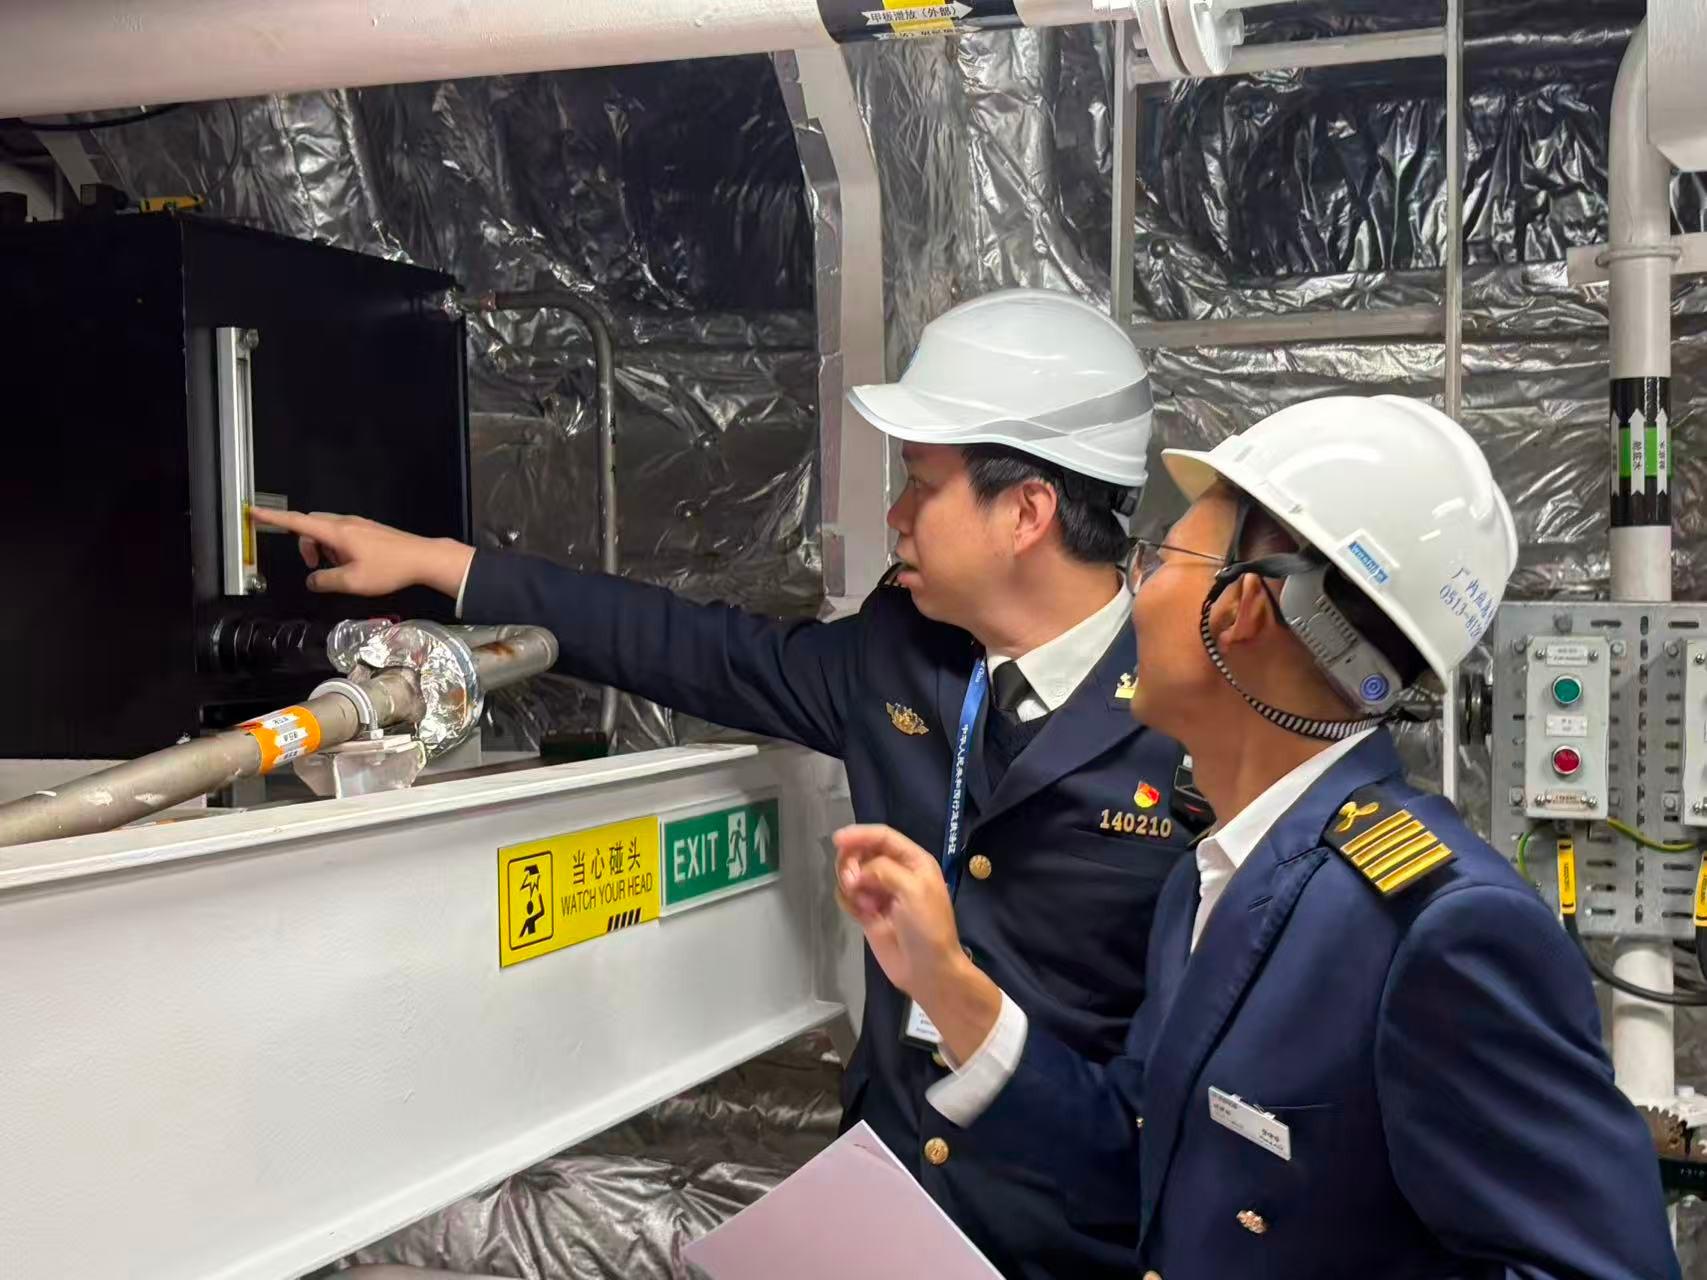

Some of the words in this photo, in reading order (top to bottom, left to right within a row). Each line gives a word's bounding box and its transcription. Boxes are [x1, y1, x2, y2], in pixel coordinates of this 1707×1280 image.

[1100, 808, 1172, 838] 140210
[572, 836, 641, 885] 当心碰头
[673, 831, 719, 884] EXIT
[561, 889, 597, 916] WATCH
[599, 880, 626, 905] YOUR
[628, 872, 653, 897] HEAD
